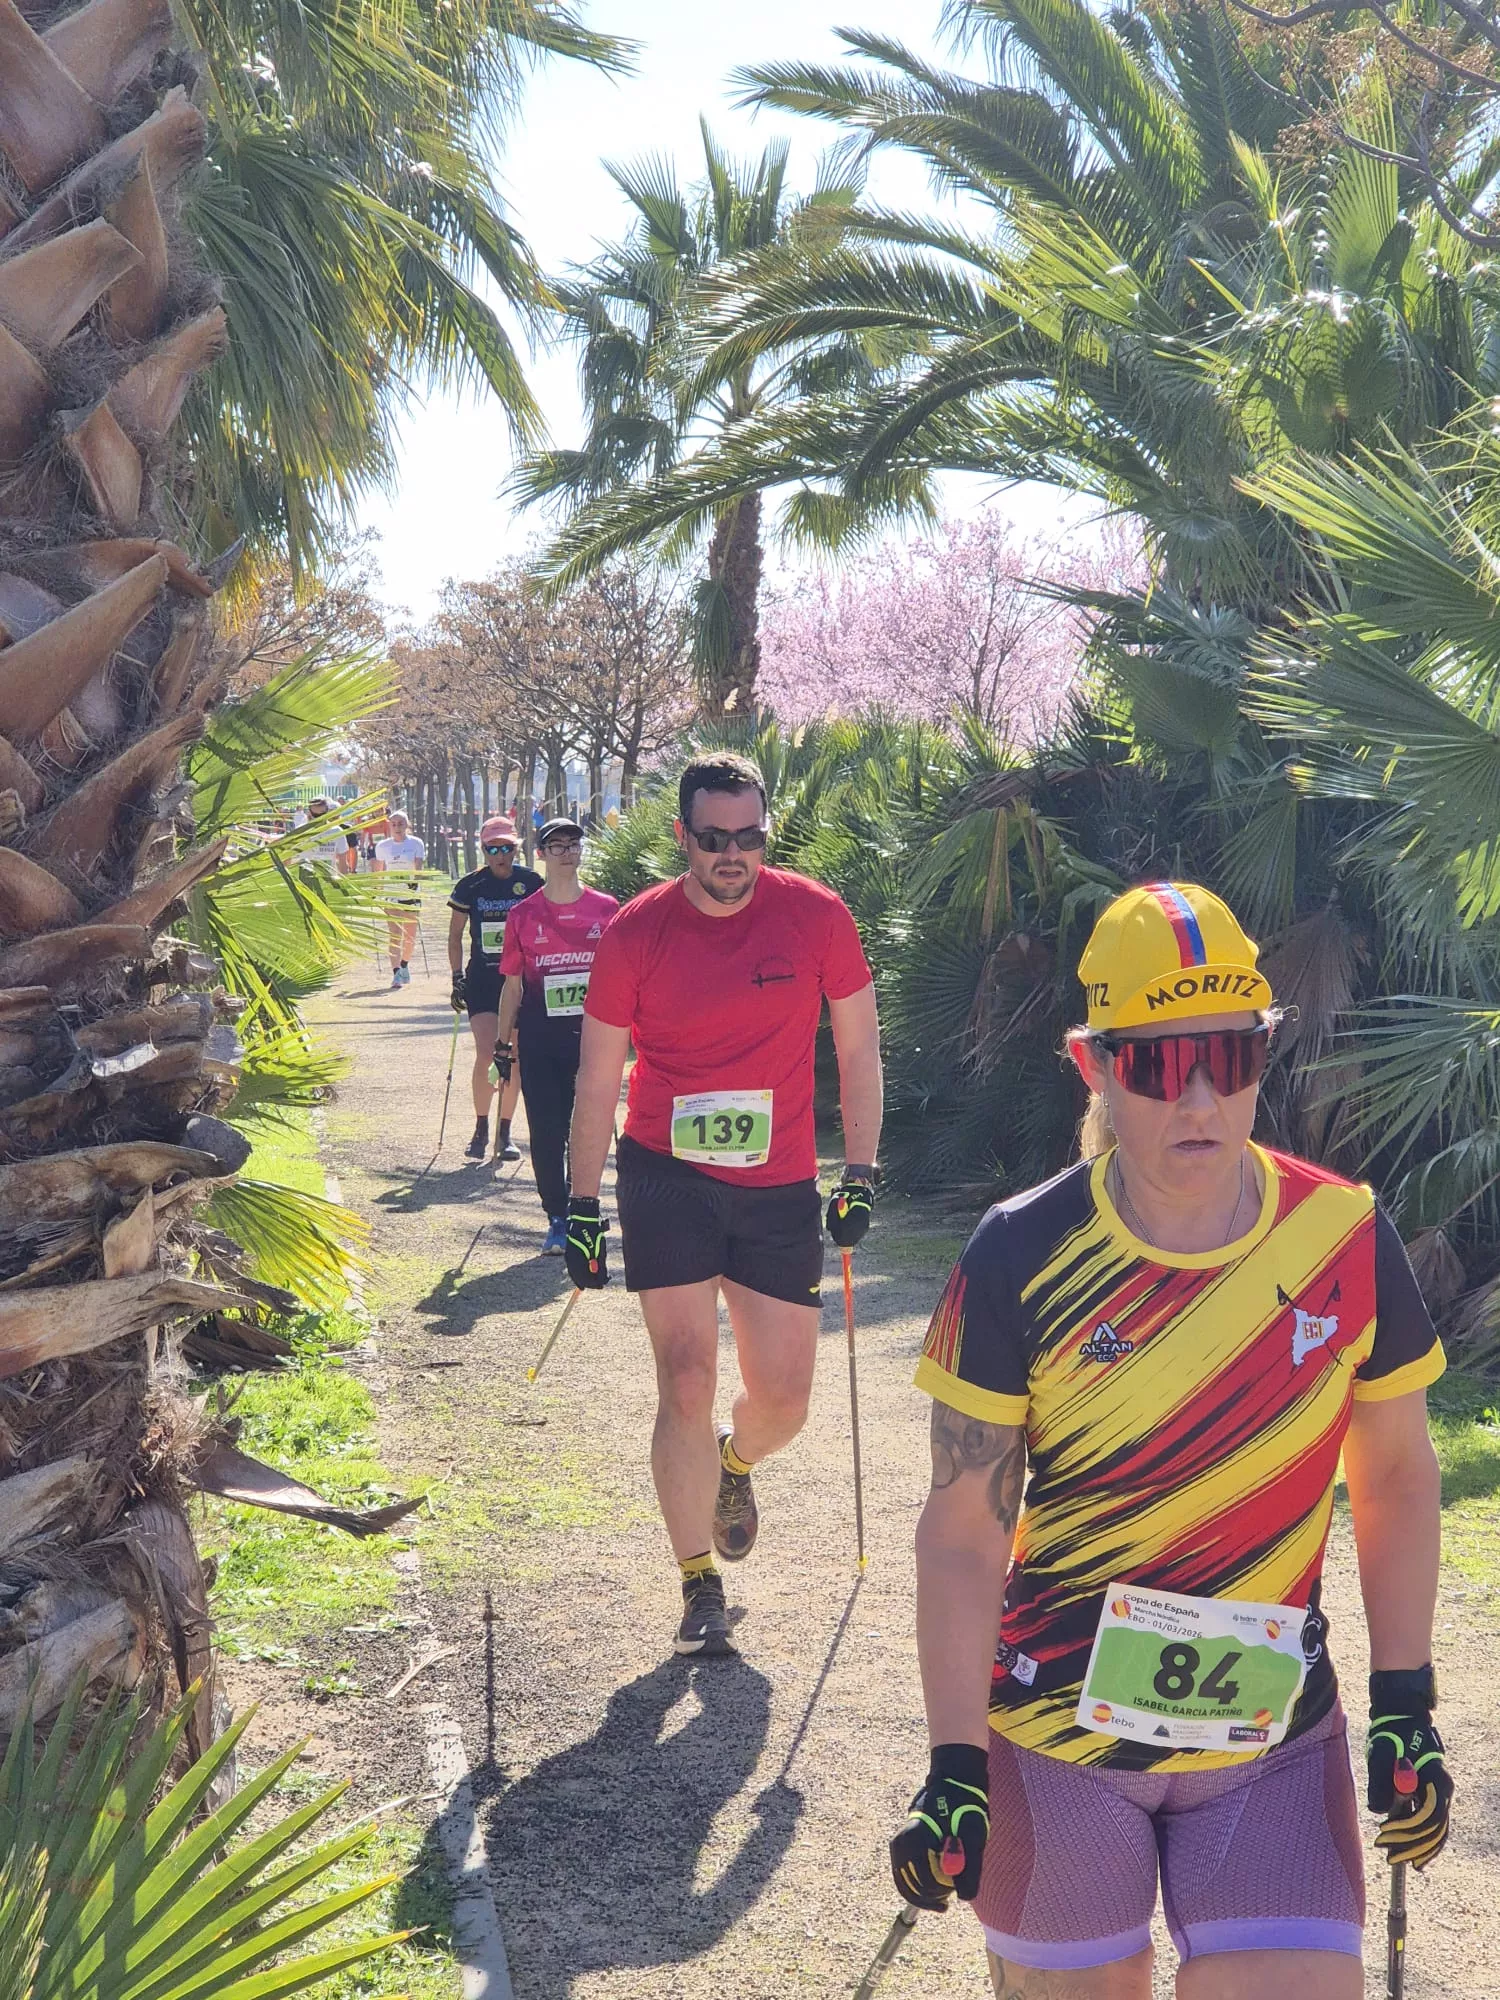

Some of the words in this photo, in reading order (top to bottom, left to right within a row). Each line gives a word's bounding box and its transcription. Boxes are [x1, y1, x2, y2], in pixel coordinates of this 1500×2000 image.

[556, 985, 587, 1004] 173
[1145, 974, 1264, 1011] MORITZ
[692, 1114, 754, 1145] 139
[1081, 1342, 1132, 1353] ALTAN
[1123, 1593, 1149, 1605] Copa
[1150, 1599, 1163, 1609] de
[1163, 1602, 1200, 1619] España
[1127, 1613, 1146, 1624] EBO
[1152, 1620, 1203, 1639] 01/03/2026
[1153, 1642, 1243, 1706] 84
[1133, 1695, 1169, 1713] ISABEL
[1171, 1705, 1208, 1718] GARCIA
[1208, 1706, 1243, 1718] PATIÑO
[1110, 1715, 1136, 1729] tebo
[1409, 1729, 1425, 1752] LEKI
